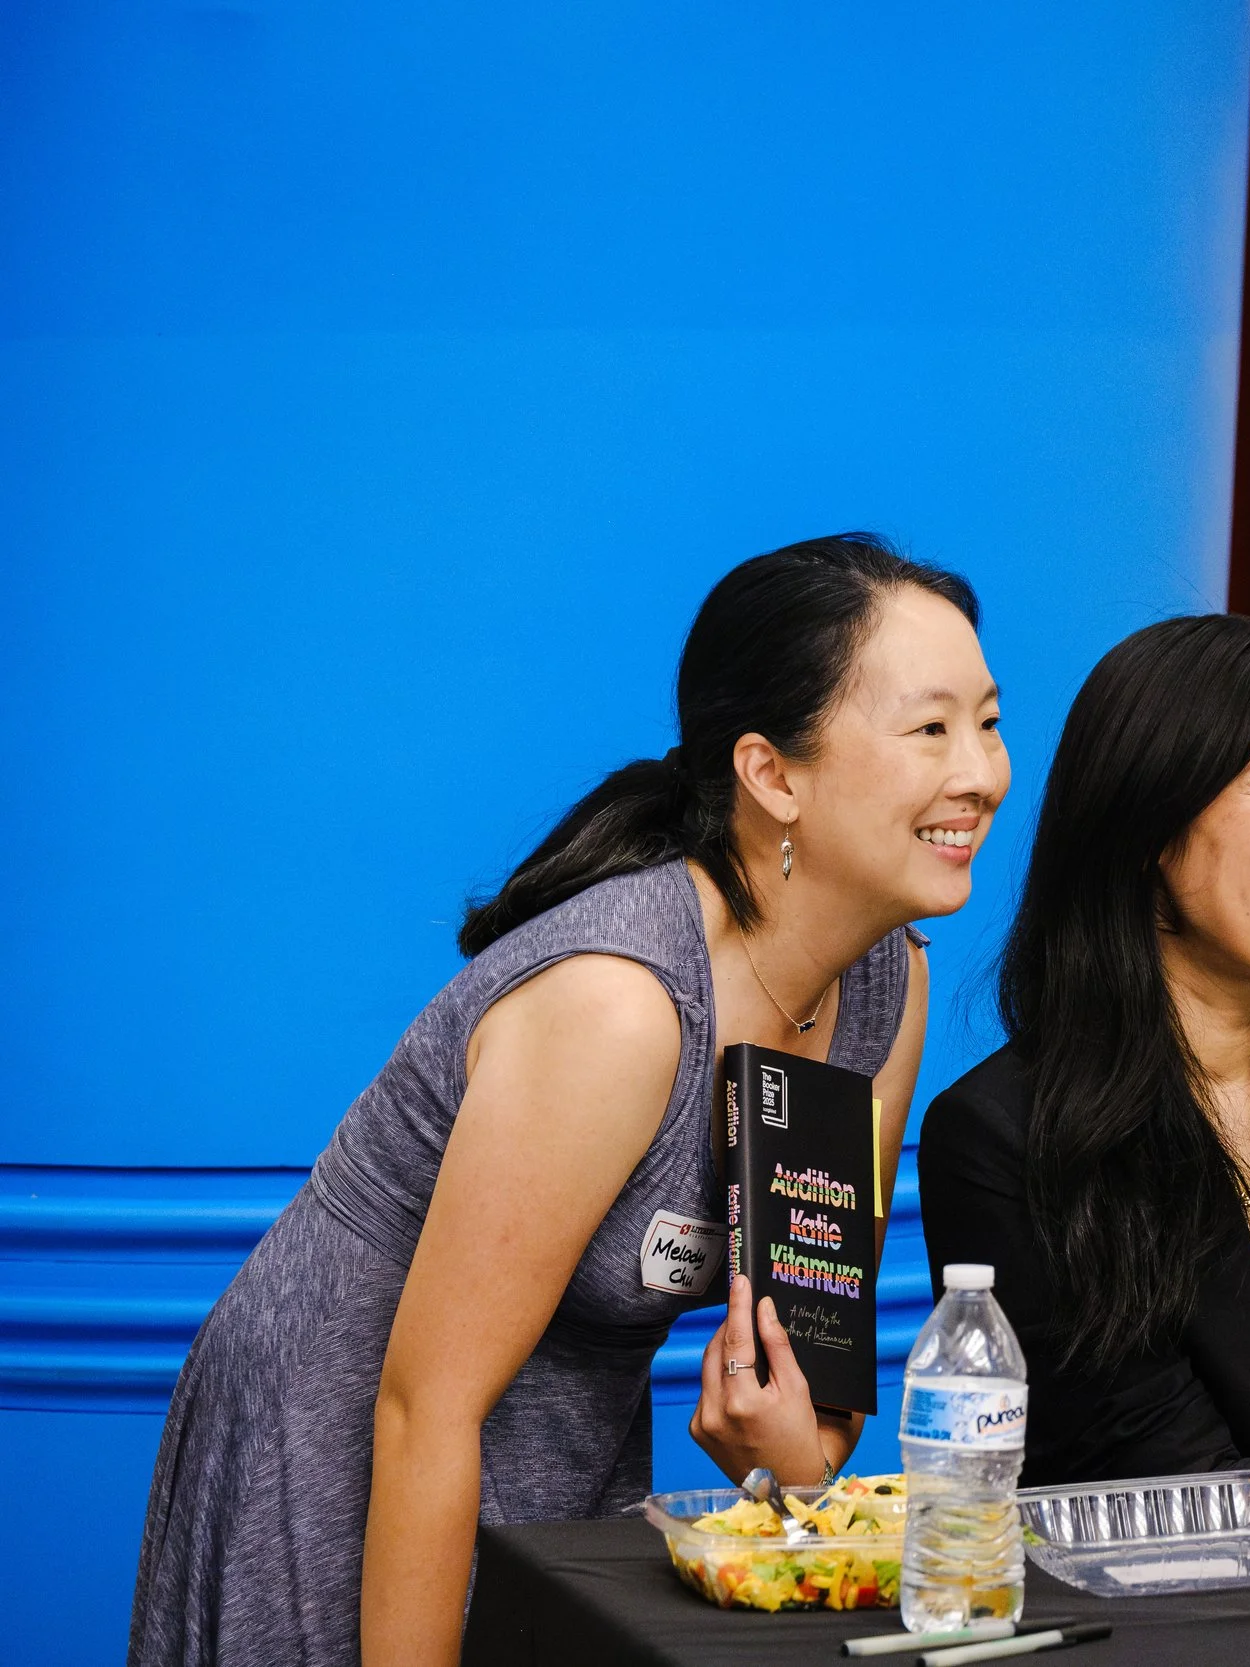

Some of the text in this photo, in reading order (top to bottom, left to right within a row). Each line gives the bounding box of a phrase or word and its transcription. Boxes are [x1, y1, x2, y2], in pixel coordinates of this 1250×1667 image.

[762, 1071, 772, 1082] The
[762, 1080, 781, 1092] Booker
[762, 1088, 775, 1099] Prize
[762, 1097, 775, 1107] 2025
[726, 1080, 742, 1287] Audition Katie Kitam
[770, 1162, 856, 1211] Audition
[789, 1208, 843, 1251] Katie
[652, 1237, 707, 1271] Melody
[668, 1266, 694, 1287] Chu
[770, 1243, 864, 1300] Kitamura
[790, 1304, 841, 1329] A Novel by the
[784, 1320, 804, 1336] uthor
[804, 1325, 813, 1342] of
